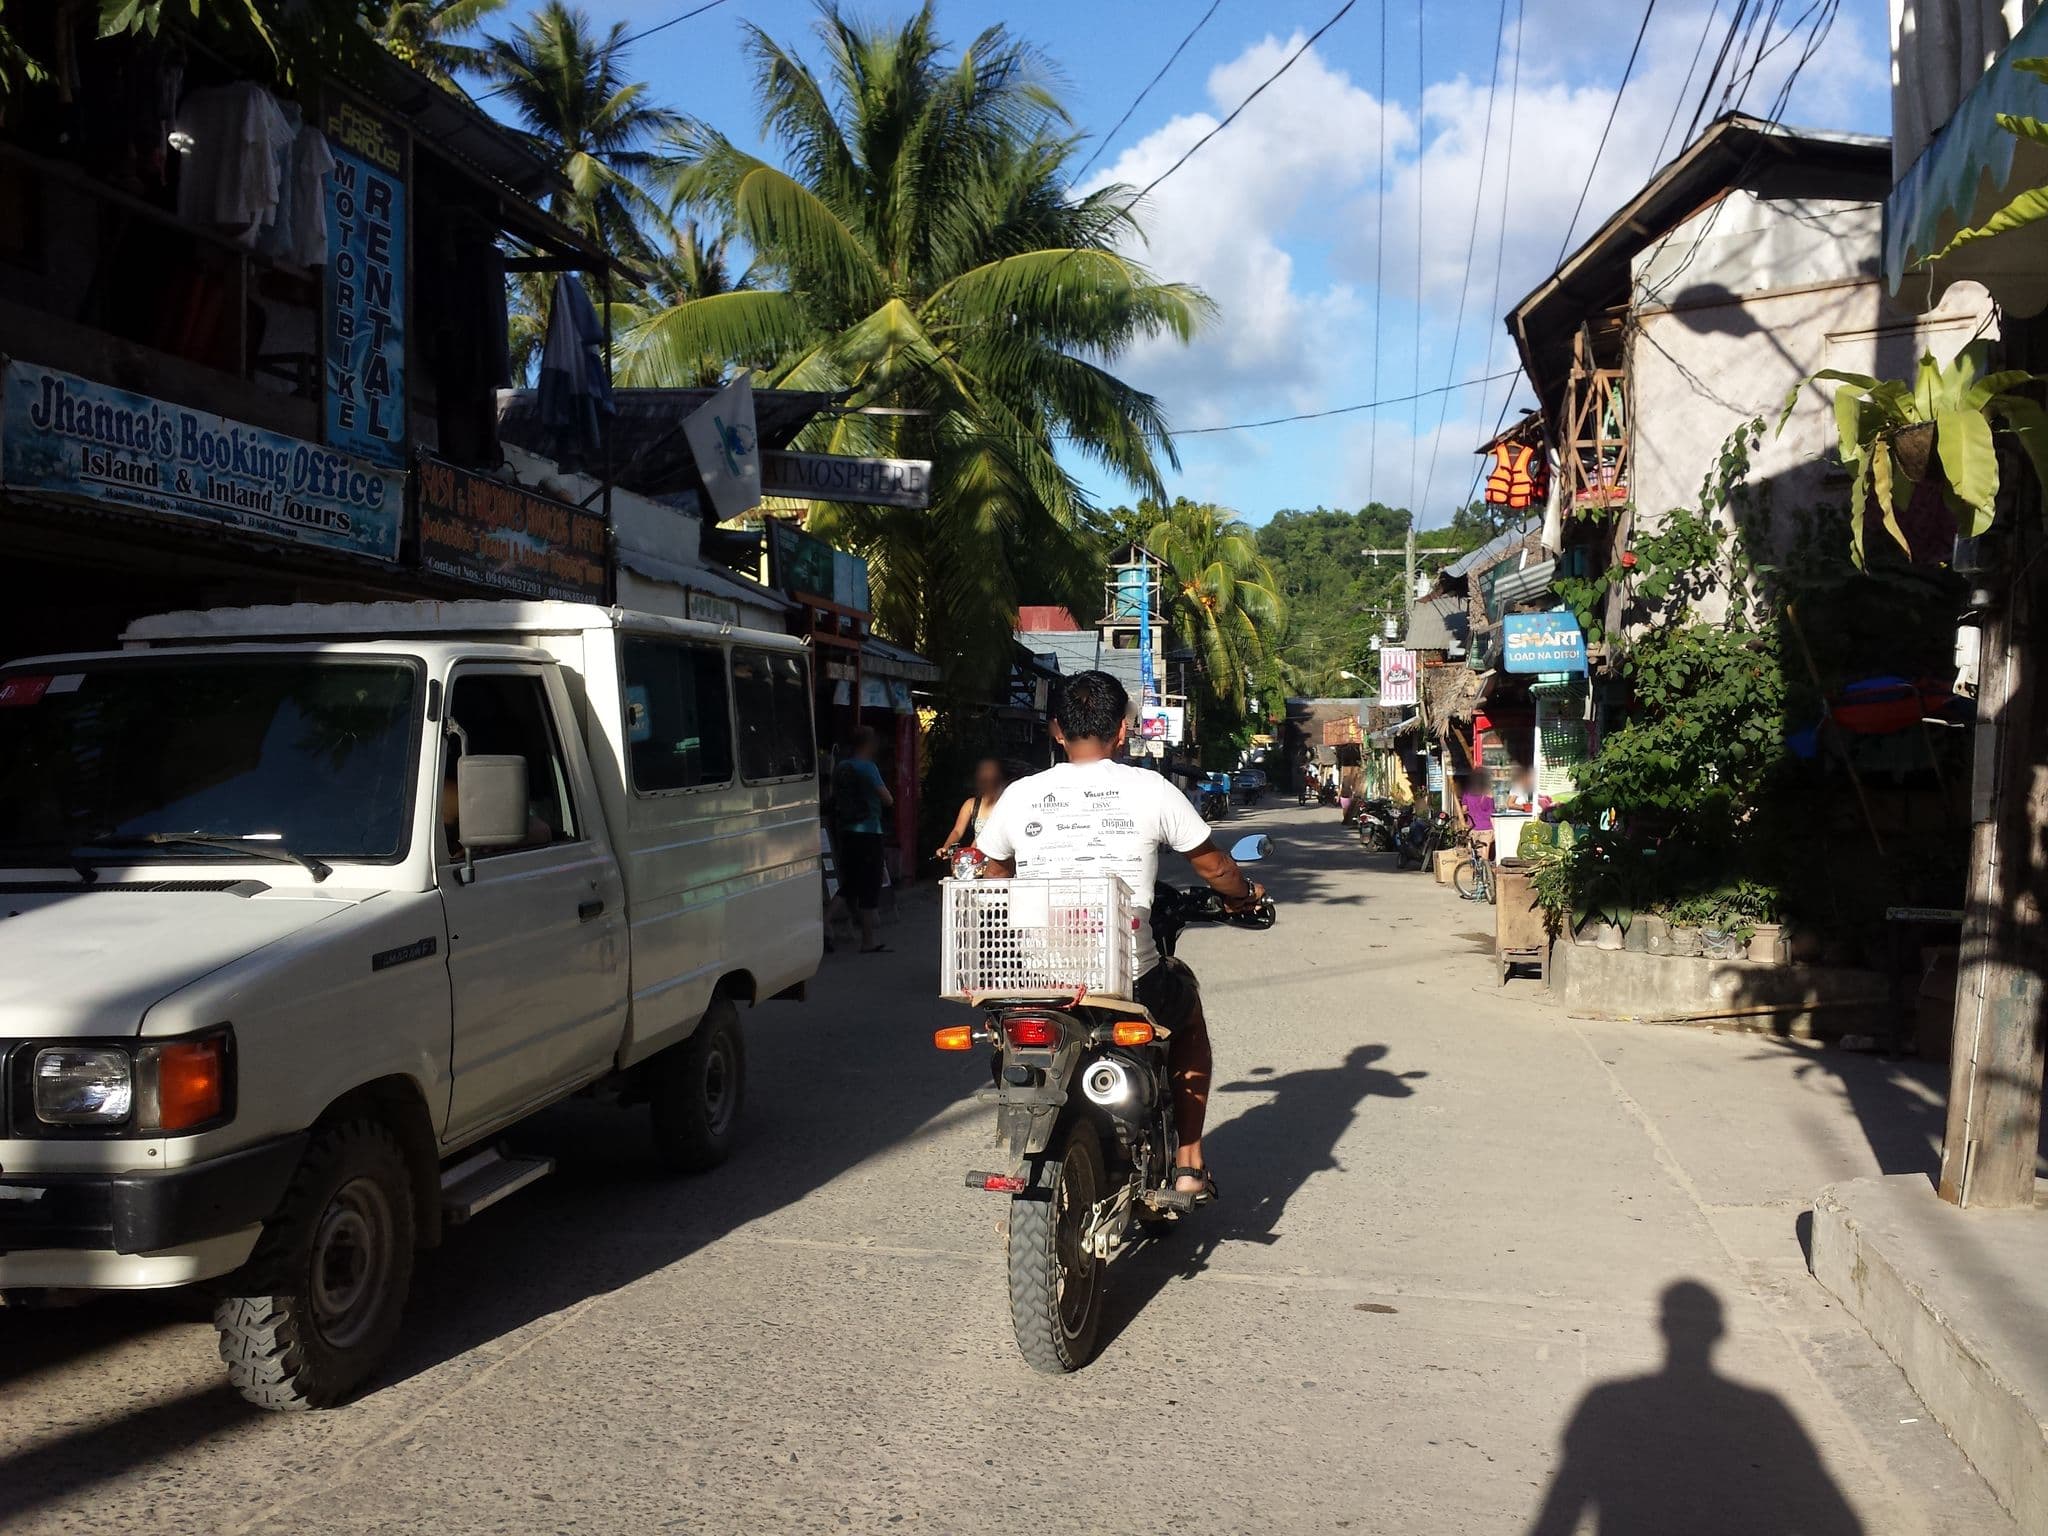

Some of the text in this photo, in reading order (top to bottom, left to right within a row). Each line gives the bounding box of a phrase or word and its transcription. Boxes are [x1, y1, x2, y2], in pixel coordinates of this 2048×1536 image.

[335, 158, 355, 430] MOTORBIKE
[363, 174, 393, 440] RENTAL
[31, 376, 384, 506] Jhanna's Booking Office
[82, 446, 159, 487] Island
[176, 468, 192, 494] &
[207, 475, 273, 513] Inland
[283, 494, 351, 530] Tours
[762, 456, 922, 493] ATMOSPHERE
[428, 555, 461, 577] Contact
[1508, 630, 1580, 649] SMART
[1509, 650, 1580, 662] LOAD NA DITO!
[1101, 818, 1135, 829] Dispatch
